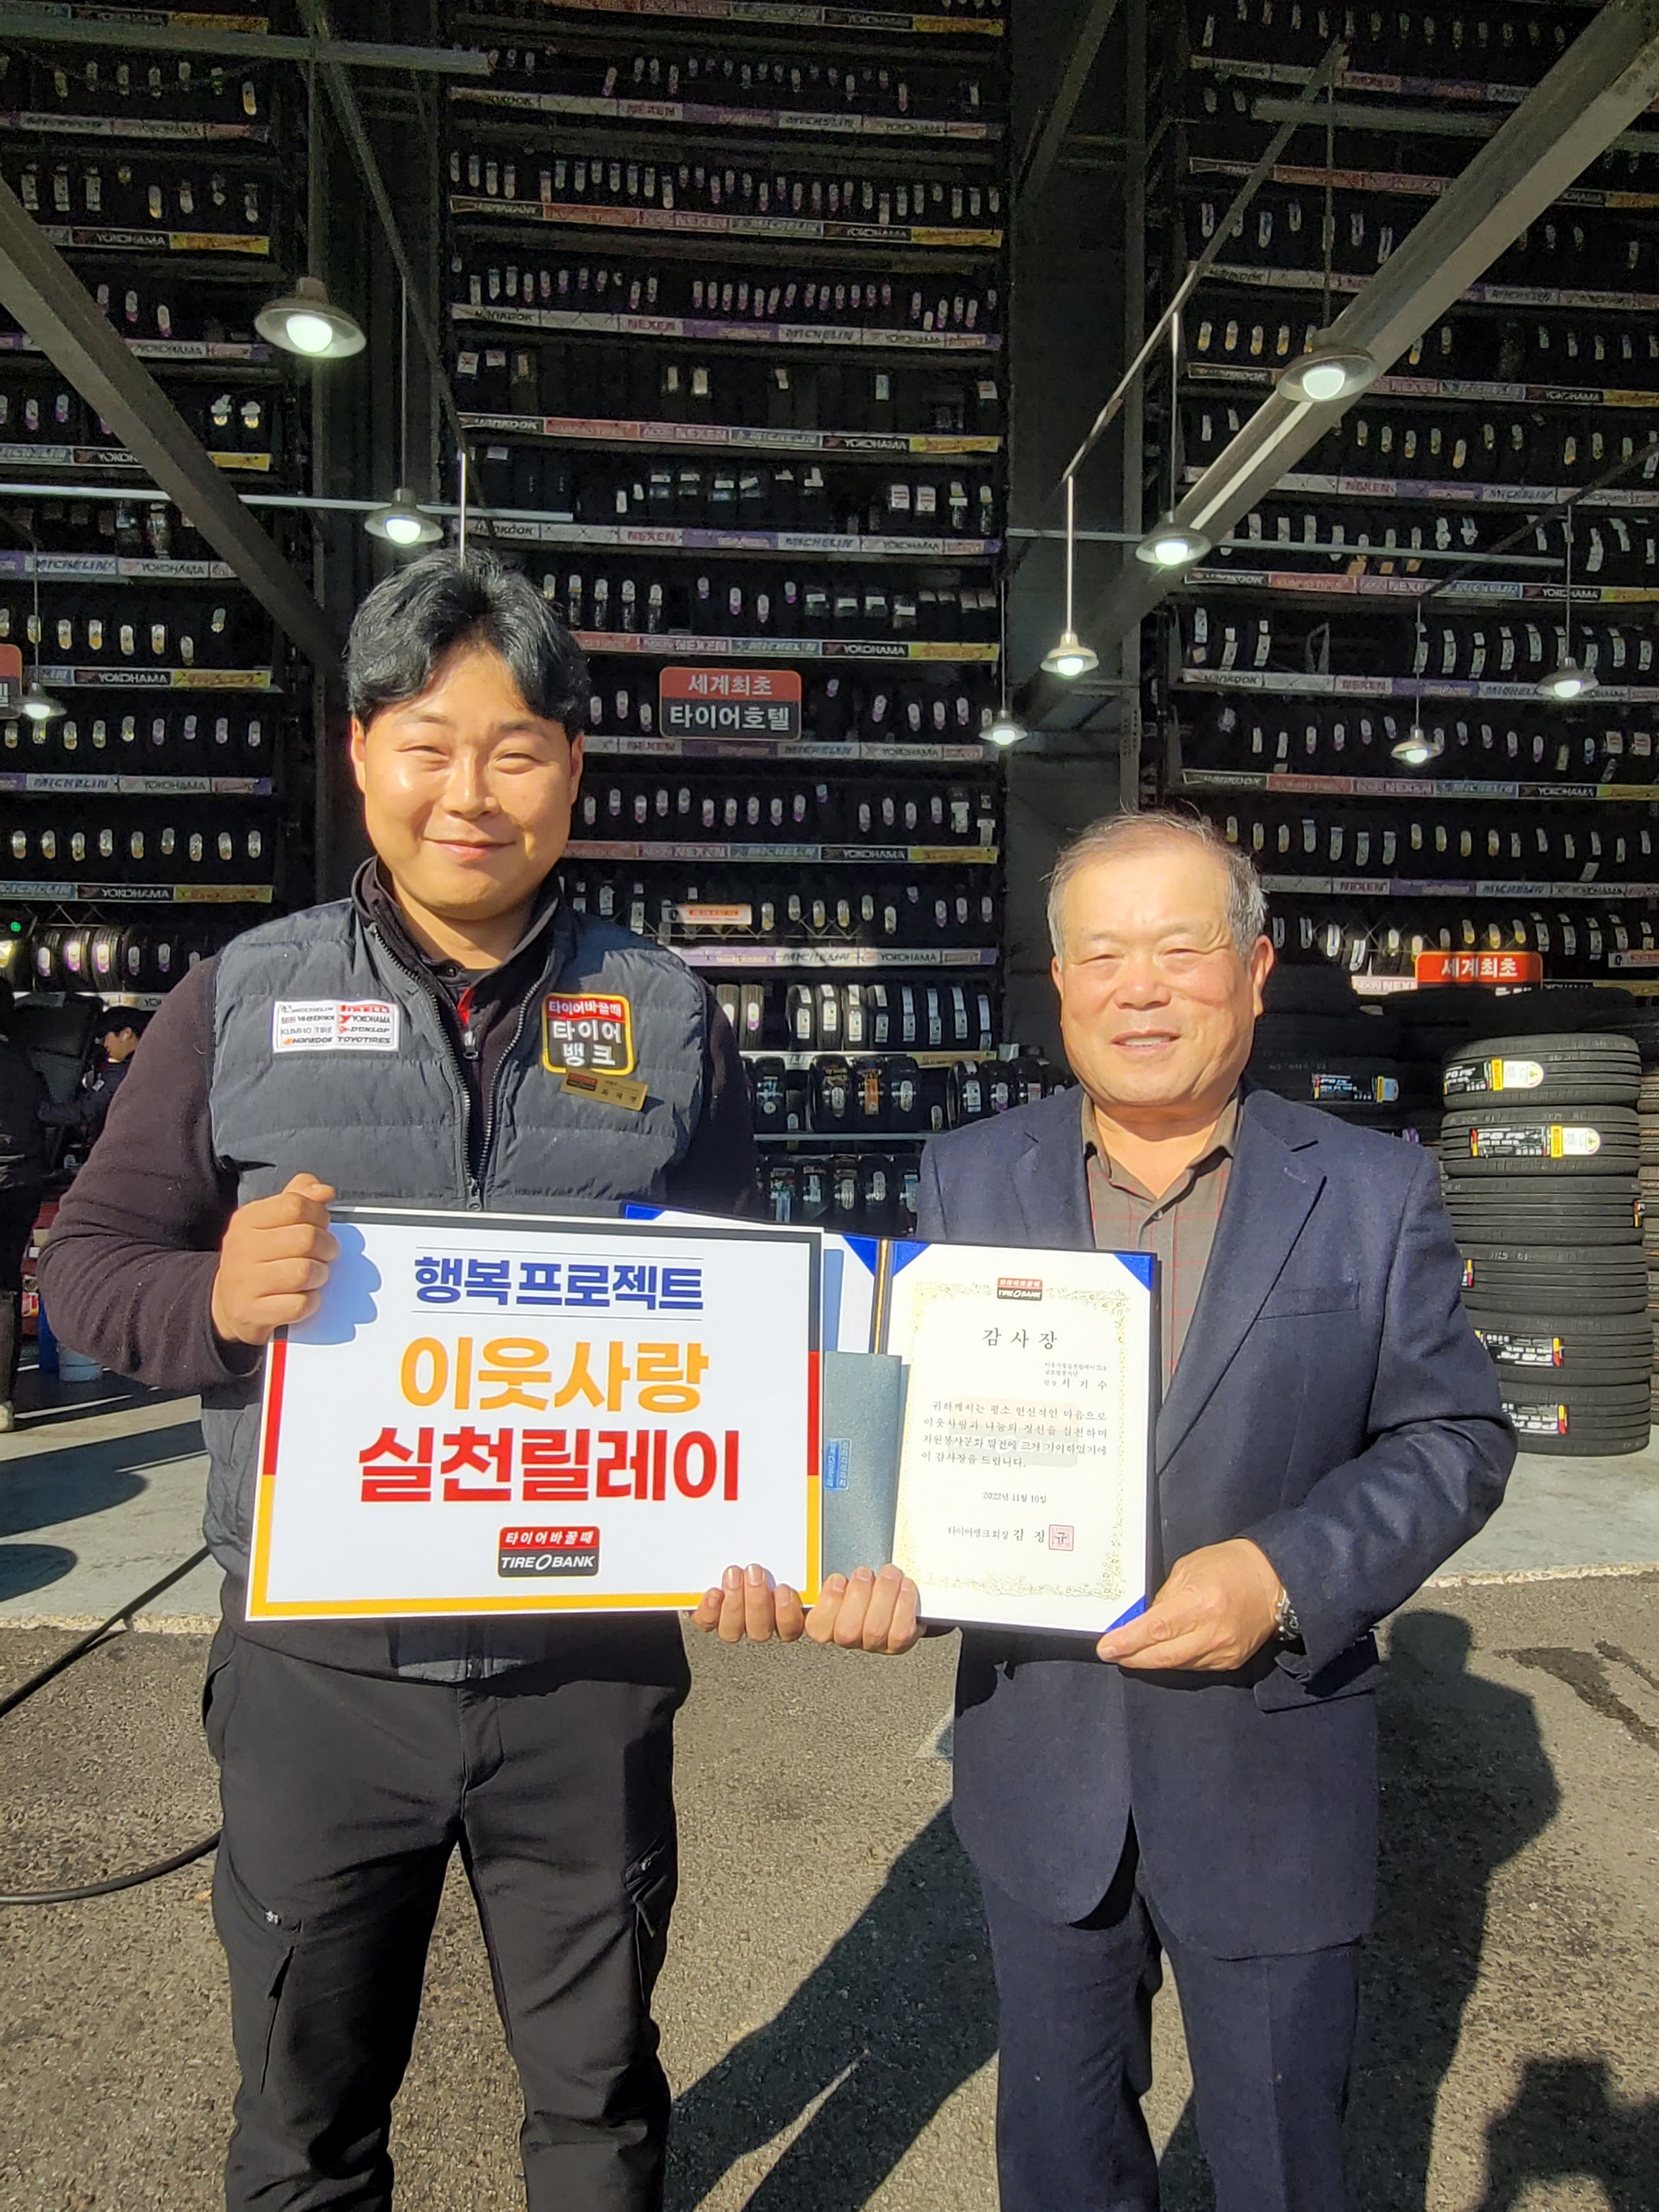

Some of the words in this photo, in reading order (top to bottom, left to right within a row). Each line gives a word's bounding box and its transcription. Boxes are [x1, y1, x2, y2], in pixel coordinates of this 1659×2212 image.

[843, 438, 908, 451] YOKOHAMA
[627, 531, 676, 543] NEXEN
[141, 562, 205, 575] YOKOHAMA
[843, 644, 906, 656] YOKOHAMA
[98, 672, 169, 684] YOKOHAMA
[687, 673, 773, 696] 세계최초
[670, 704, 790, 732] 타이어호텔
[144, 780, 207, 792] YOKOHAMA
[1537, 787, 1594, 798] YOKOHAMA
[842, 848, 905, 860] YOKOHAMA
[100, 887, 170, 899] YOKOHAMA
[880, 952, 938, 963] YOKOHAMA
[1441, 957, 1518, 979] 세계최초
[352, 1015, 391, 1023] YOKOHAMA
[552, 1019, 622, 1044] 타이어
[400, 1336, 709, 1413] 이웃사랑
[924, 1416, 979, 1431] 이웃사랑과
[1022, 1423, 1057, 1437] 정신을
[358, 1426, 740, 1502] 실천릴레이
[921, 1451, 931, 1463] 이
[934, 1451, 978, 1465] 감사장을
